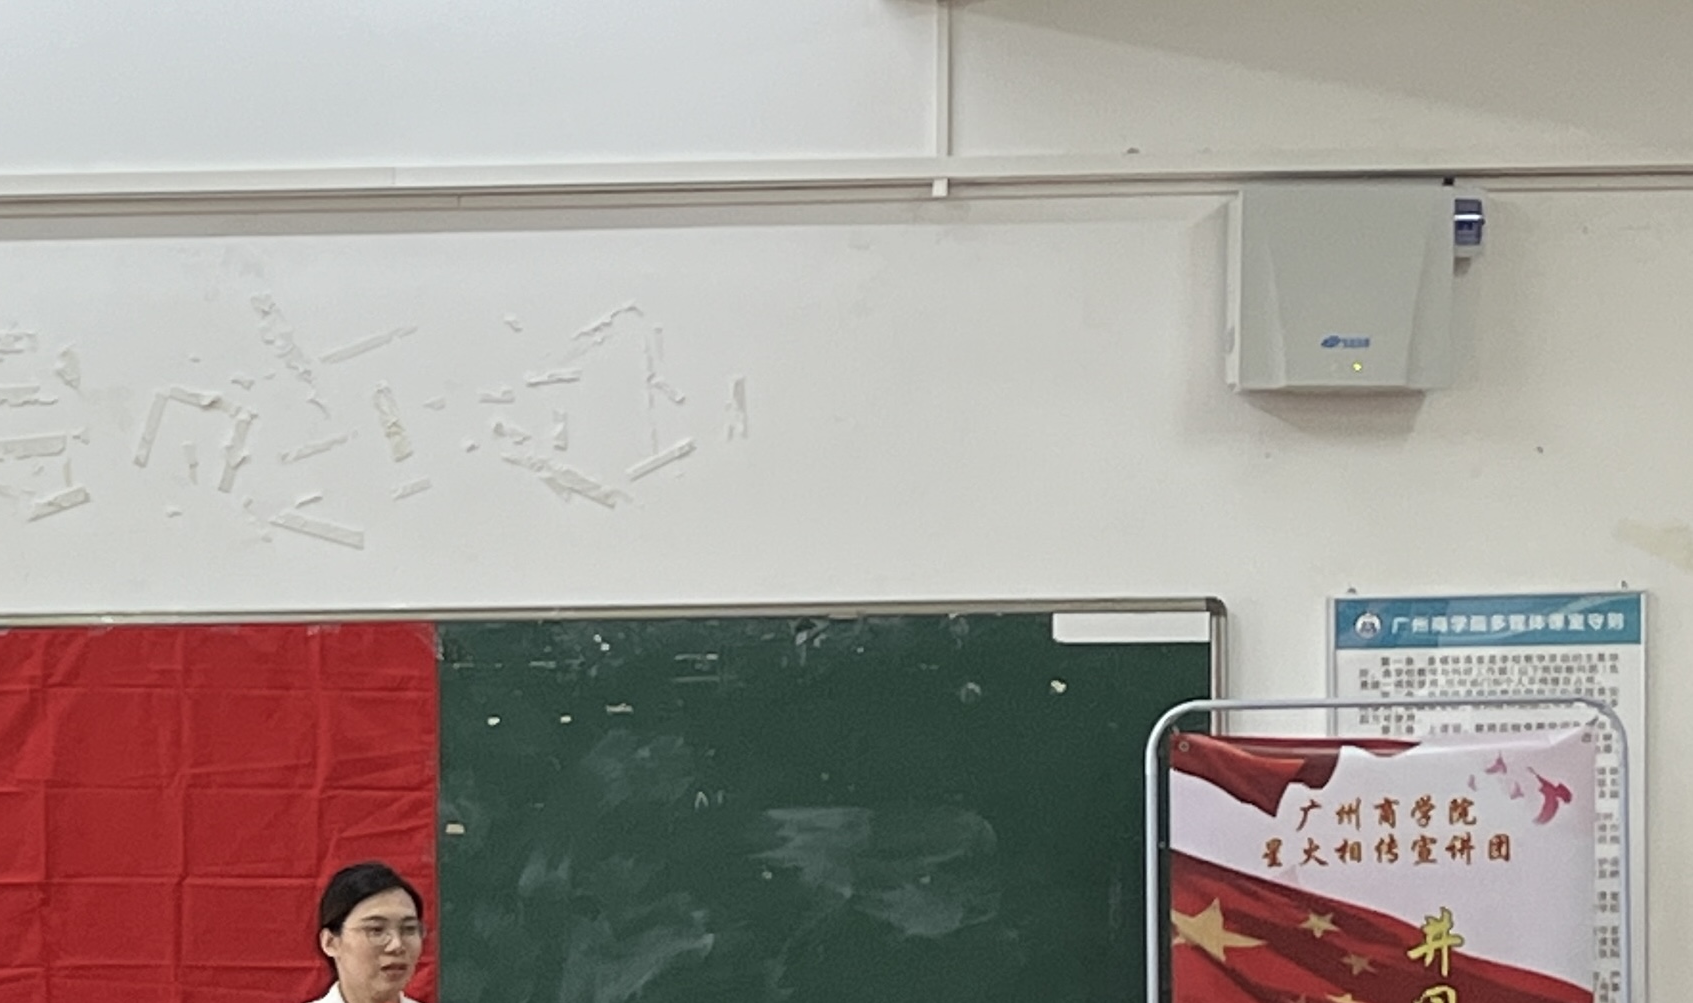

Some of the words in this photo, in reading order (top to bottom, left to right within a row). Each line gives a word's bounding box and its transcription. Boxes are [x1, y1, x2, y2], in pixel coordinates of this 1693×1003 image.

[1296, 795, 1478, 831] 广州商学院
[1261, 831, 1512, 868] 星火相传宣讲团
